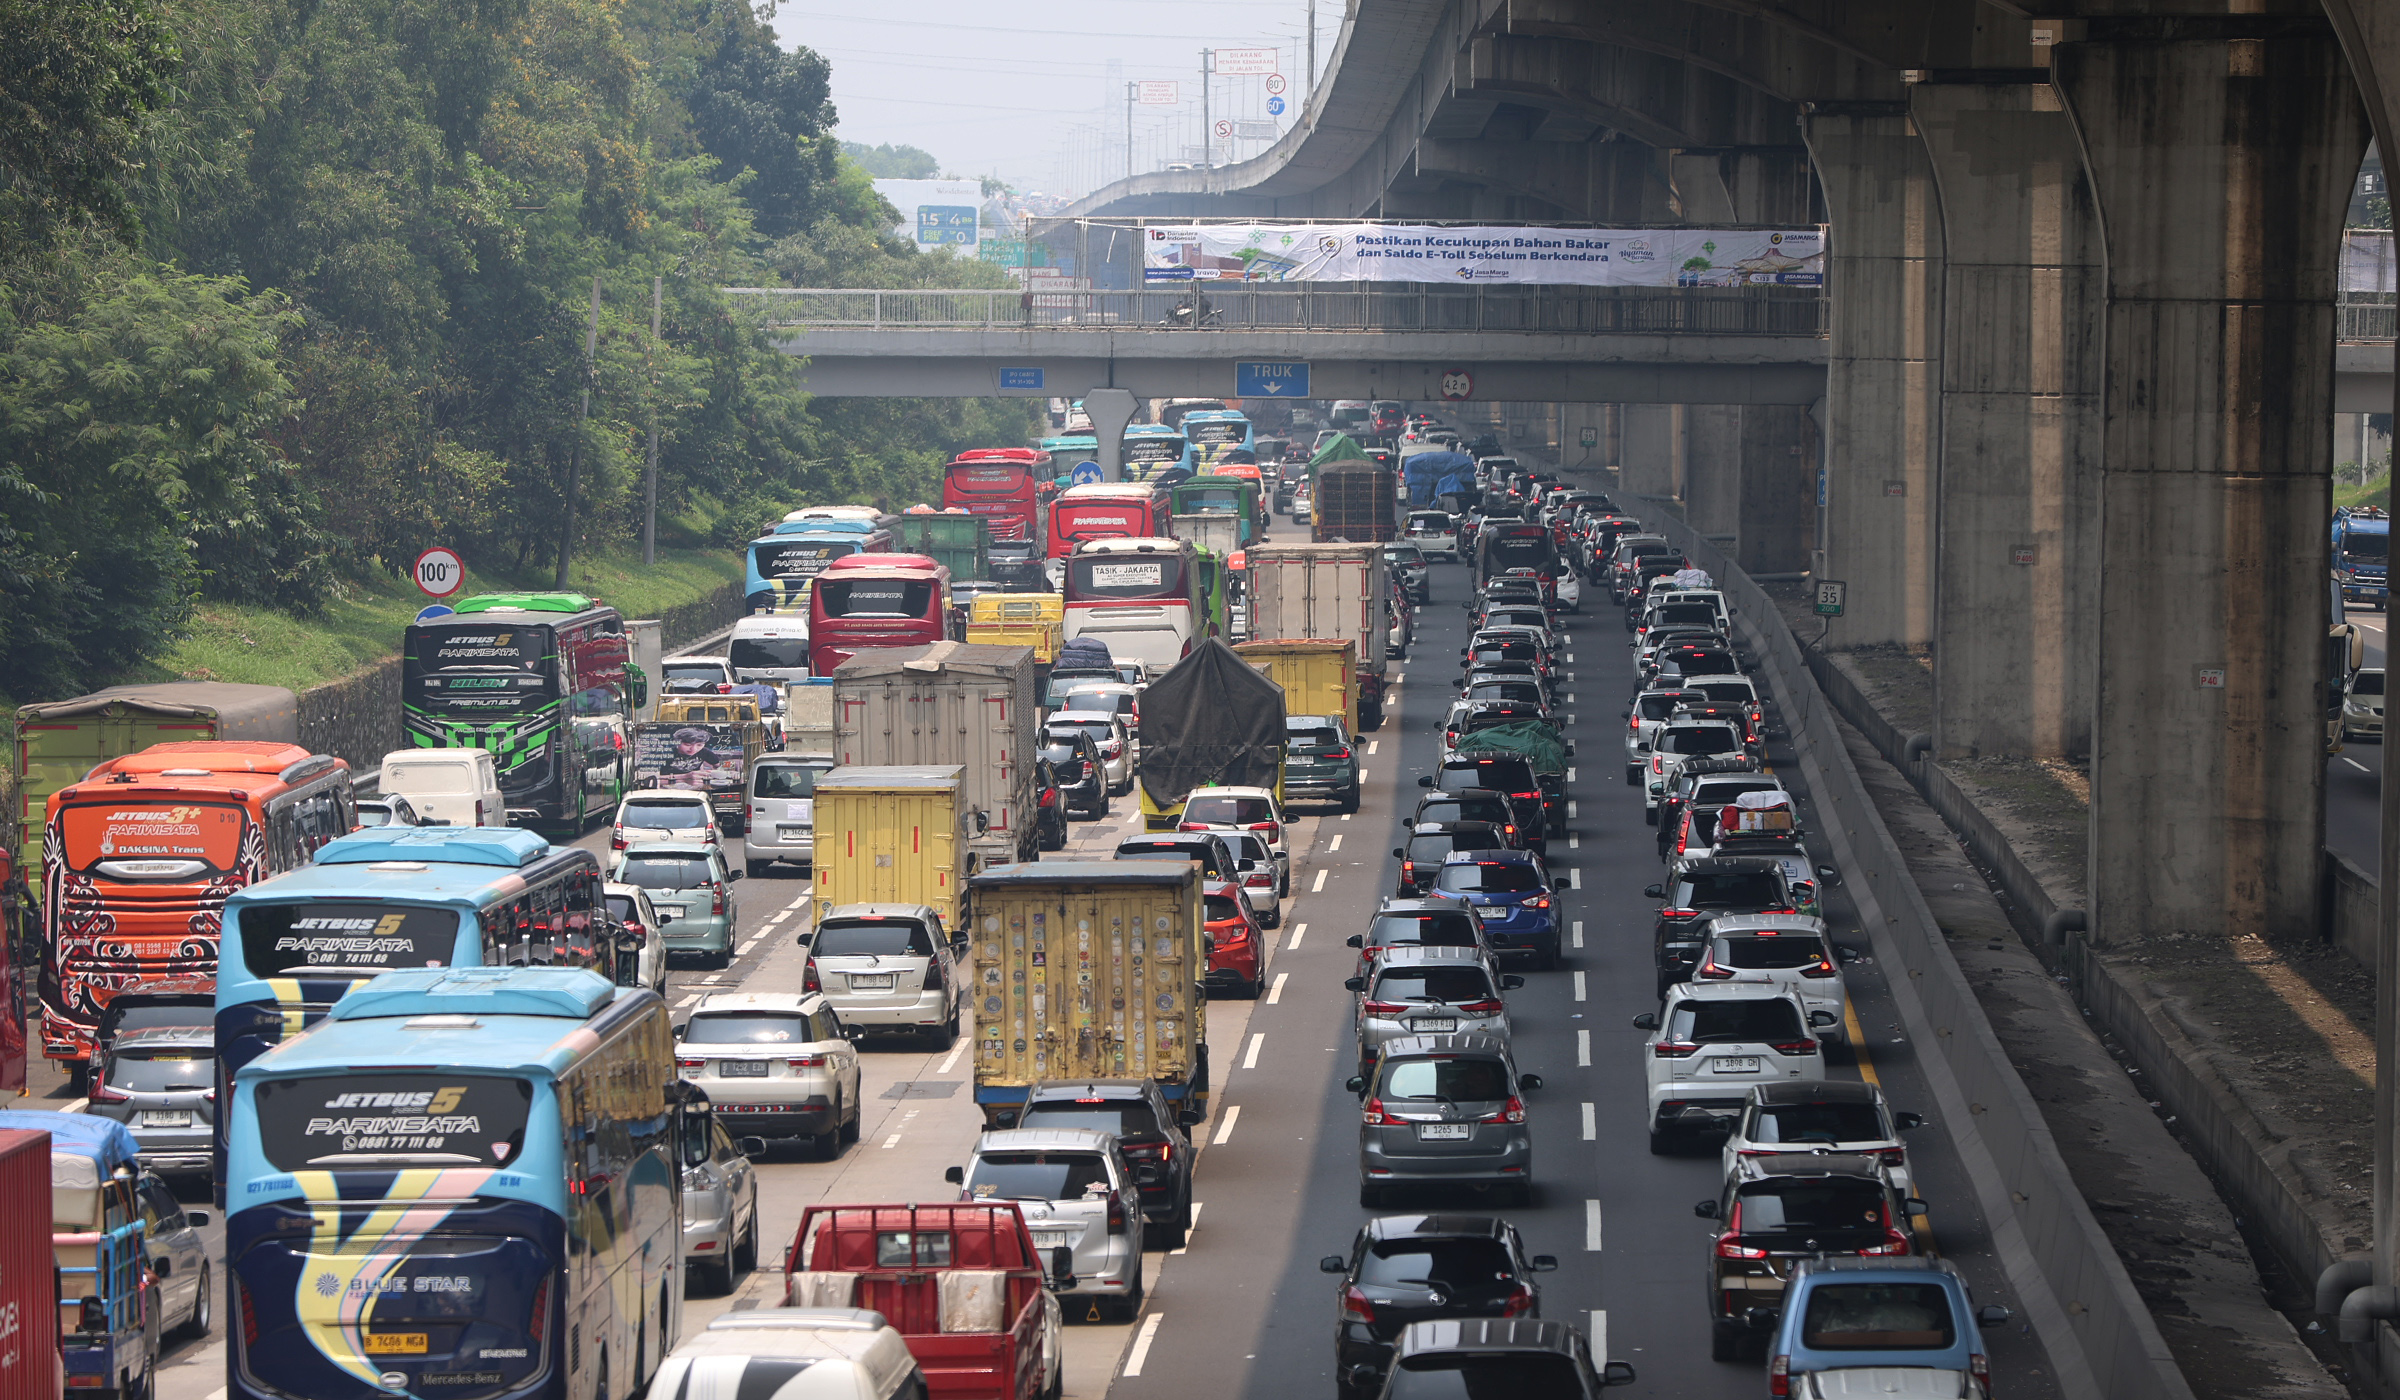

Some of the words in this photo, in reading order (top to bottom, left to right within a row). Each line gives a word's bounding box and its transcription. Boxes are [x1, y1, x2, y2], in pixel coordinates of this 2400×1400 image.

[1268, 79, 1279, 89] 80
[1267, 101, 1279, 112] 60
[1356, 235, 1422, 246] Pastikan
[1426, 236, 1510, 250] Kecukupan
[1514, 237, 1562, 249] Bahan
[1565, 239, 1611, 249] Bakar
[1356, 249, 1382, 257] dan
[1384, 249, 1423, 259] Saldo
[1426, 250, 1466, 260] E-Toll
[1468, 251, 1526, 260] Sebelum
[1530, 251, 1609, 262] Berkendara
[1618, 249, 1654, 258] Nyaman
[1253, 364, 1293, 378] TRUK
[1444, 378, 1458, 390] 4.2
[1460, 382, 1468, 390] m
[815, 548, 831, 559] 5
[772, 559, 834, 567] PARIWISATA
[420, 562, 446, 583] 100
[446, 562, 458, 570] km
[1124, 566, 1158, 574] JAKARTA
[1821, 591, 1836, 604] 35
[445, 636, 497, 644] JETBUS
[494, 633, 513, 647] 5
[438, 647, 520, 658] PARIWISATA
[449, 679, 510, 688] HILAN
[2201, 676, 2206, 685] P
[107, 812, 171, 820] JETBUS
[166, 807, 201, 824] 3+
[220, 814, 225, 823] D
[227, 814, 236, 823] 10
[109, 824, 200, 836] PARIWISATA
[119, 846, 169, 854] DAKSINA
[290, 918, 376, 930] JETBUS
[373, 914, 406, 935] 5
[275, 937, 414, 952] PARIWISATA
[853, 975, 857, 983] B
[325, 1092, 434, 1108] JETBUS
[427, 1086, 468, 1114] 5
[305, 1116, 481, 1135] PARIWISATA
[1423, 1126, 1427, 1134] A
[1433, 1125, 1451, 1134] 1265
[1457, 1126, 1467, 1134] AU
[350, 1277, 407, 1292] BLUE
[414, 1277, 472, 1292] STAR
[365, 1336, 372, 1347] B
[422, 1372, 501, 1386] Mercedes-Benz
